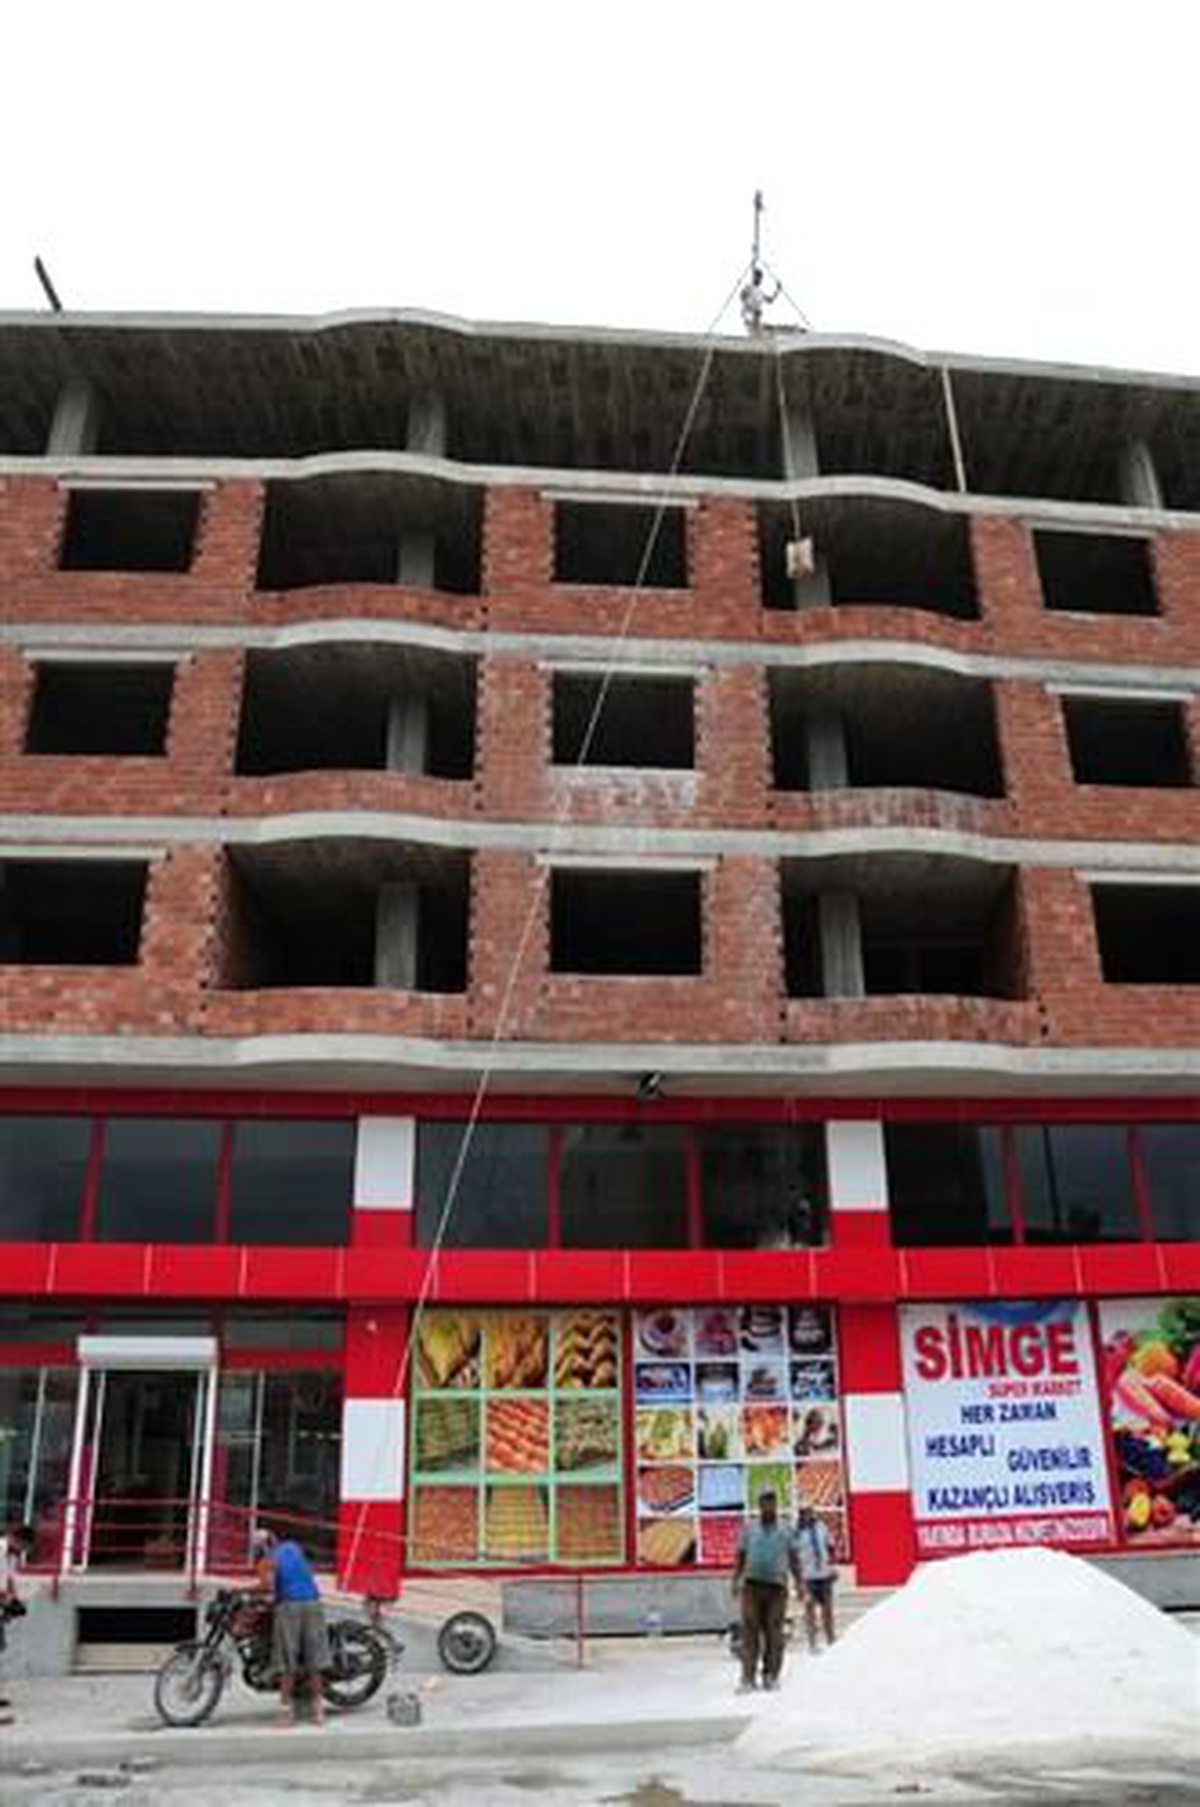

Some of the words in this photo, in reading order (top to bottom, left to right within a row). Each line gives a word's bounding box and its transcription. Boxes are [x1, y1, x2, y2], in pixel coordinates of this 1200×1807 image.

[915, 1313, 1078, 1380] SİMGE
[961, 1405, 994, 1424] HER
[1000, 1402, 1056, 1421] ZAMAN
[926, 1435, 995, 1457] HESAPLI
[929, 1487, 1008, 1511] KAZANÇLI
